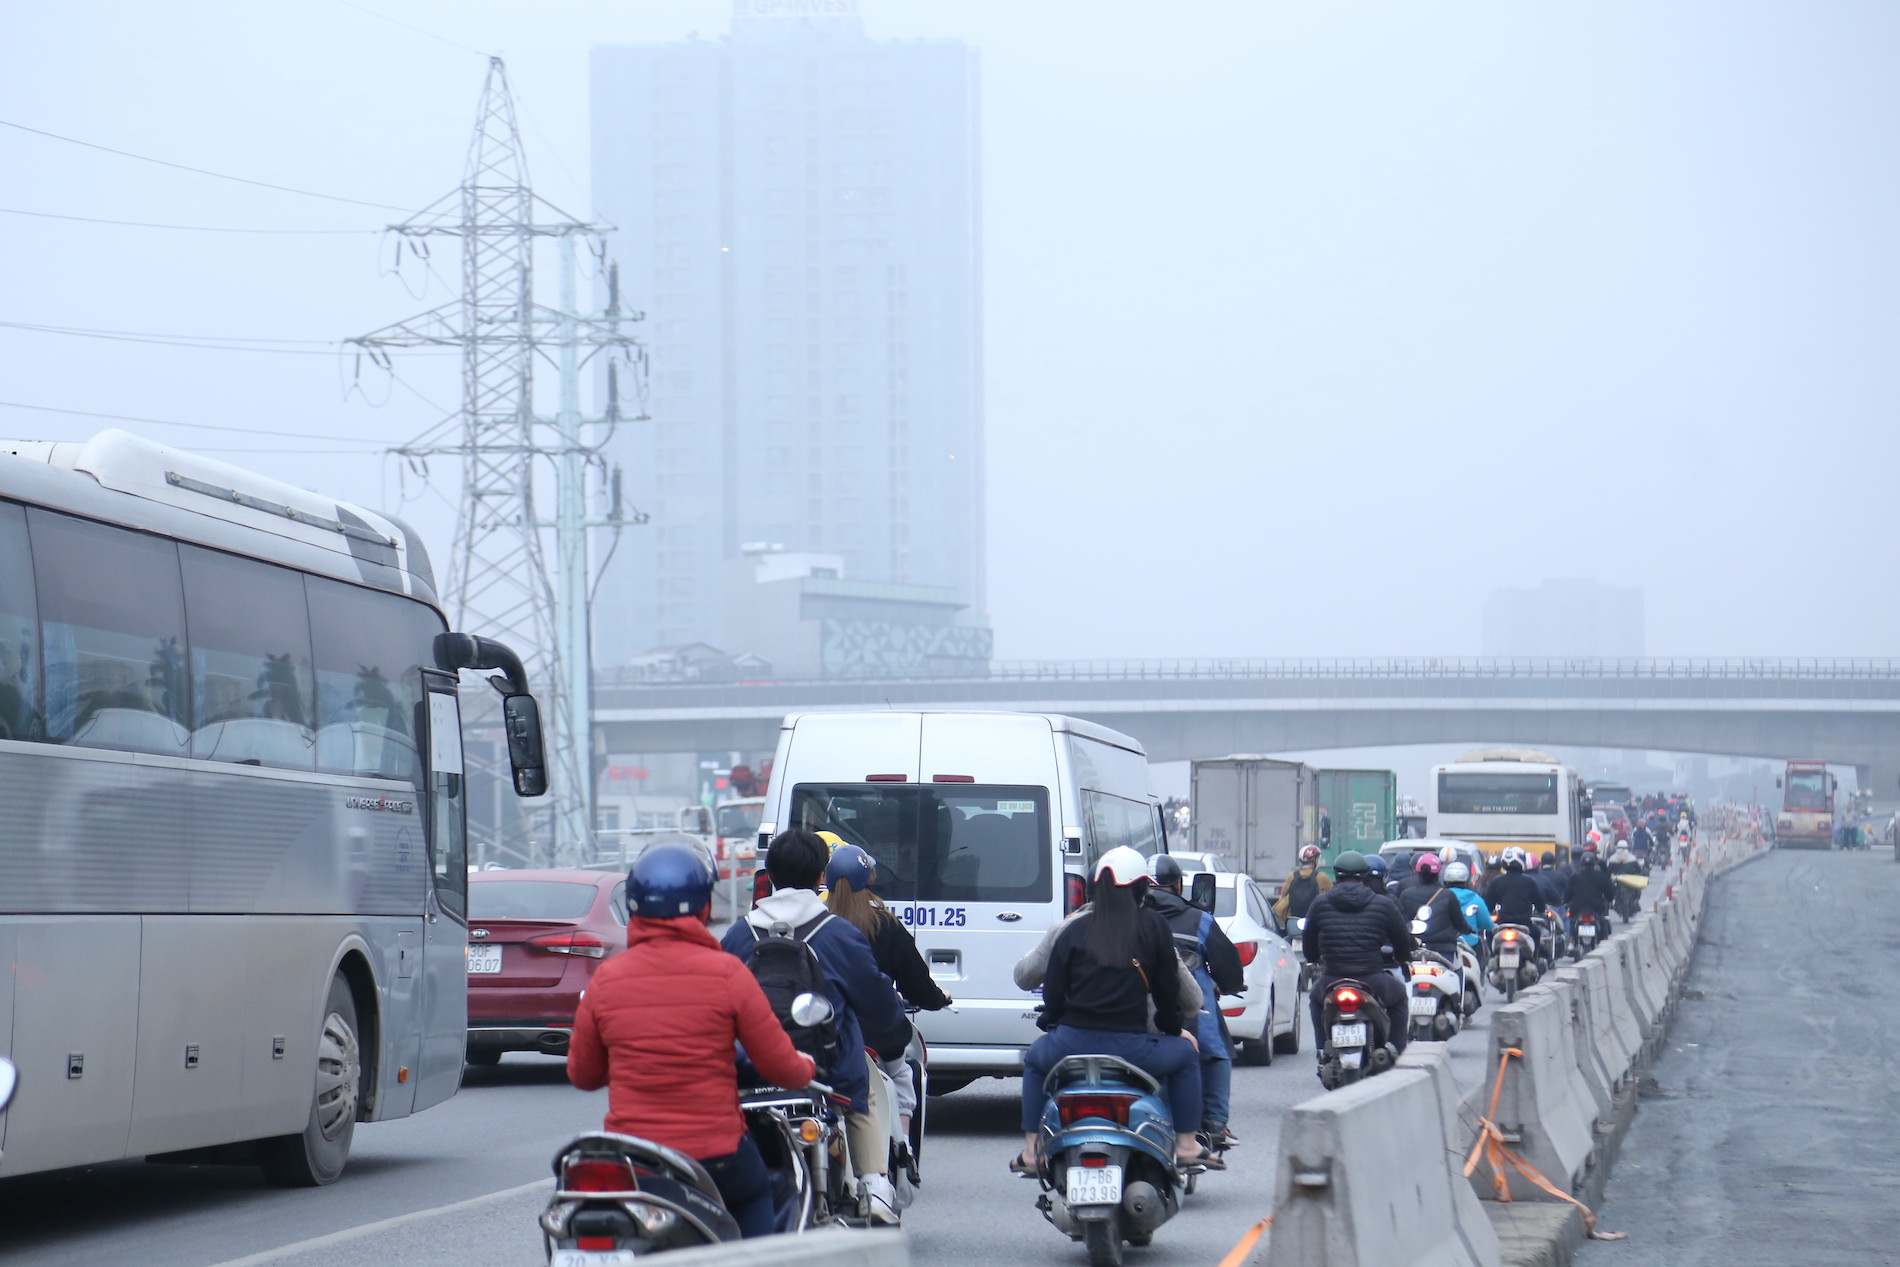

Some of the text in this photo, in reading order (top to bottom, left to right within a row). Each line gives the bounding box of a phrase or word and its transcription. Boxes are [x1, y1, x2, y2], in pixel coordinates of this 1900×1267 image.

[470, 944, 491, 957] 30F
[1337, 1025, 1361, 1036] 29-G1
[1334, 1035, 1364, 1046] 239.36
[1077, 1169, 1113, 1185] 17-B6
[1071, 1186, 1117, 1202] 023.96
